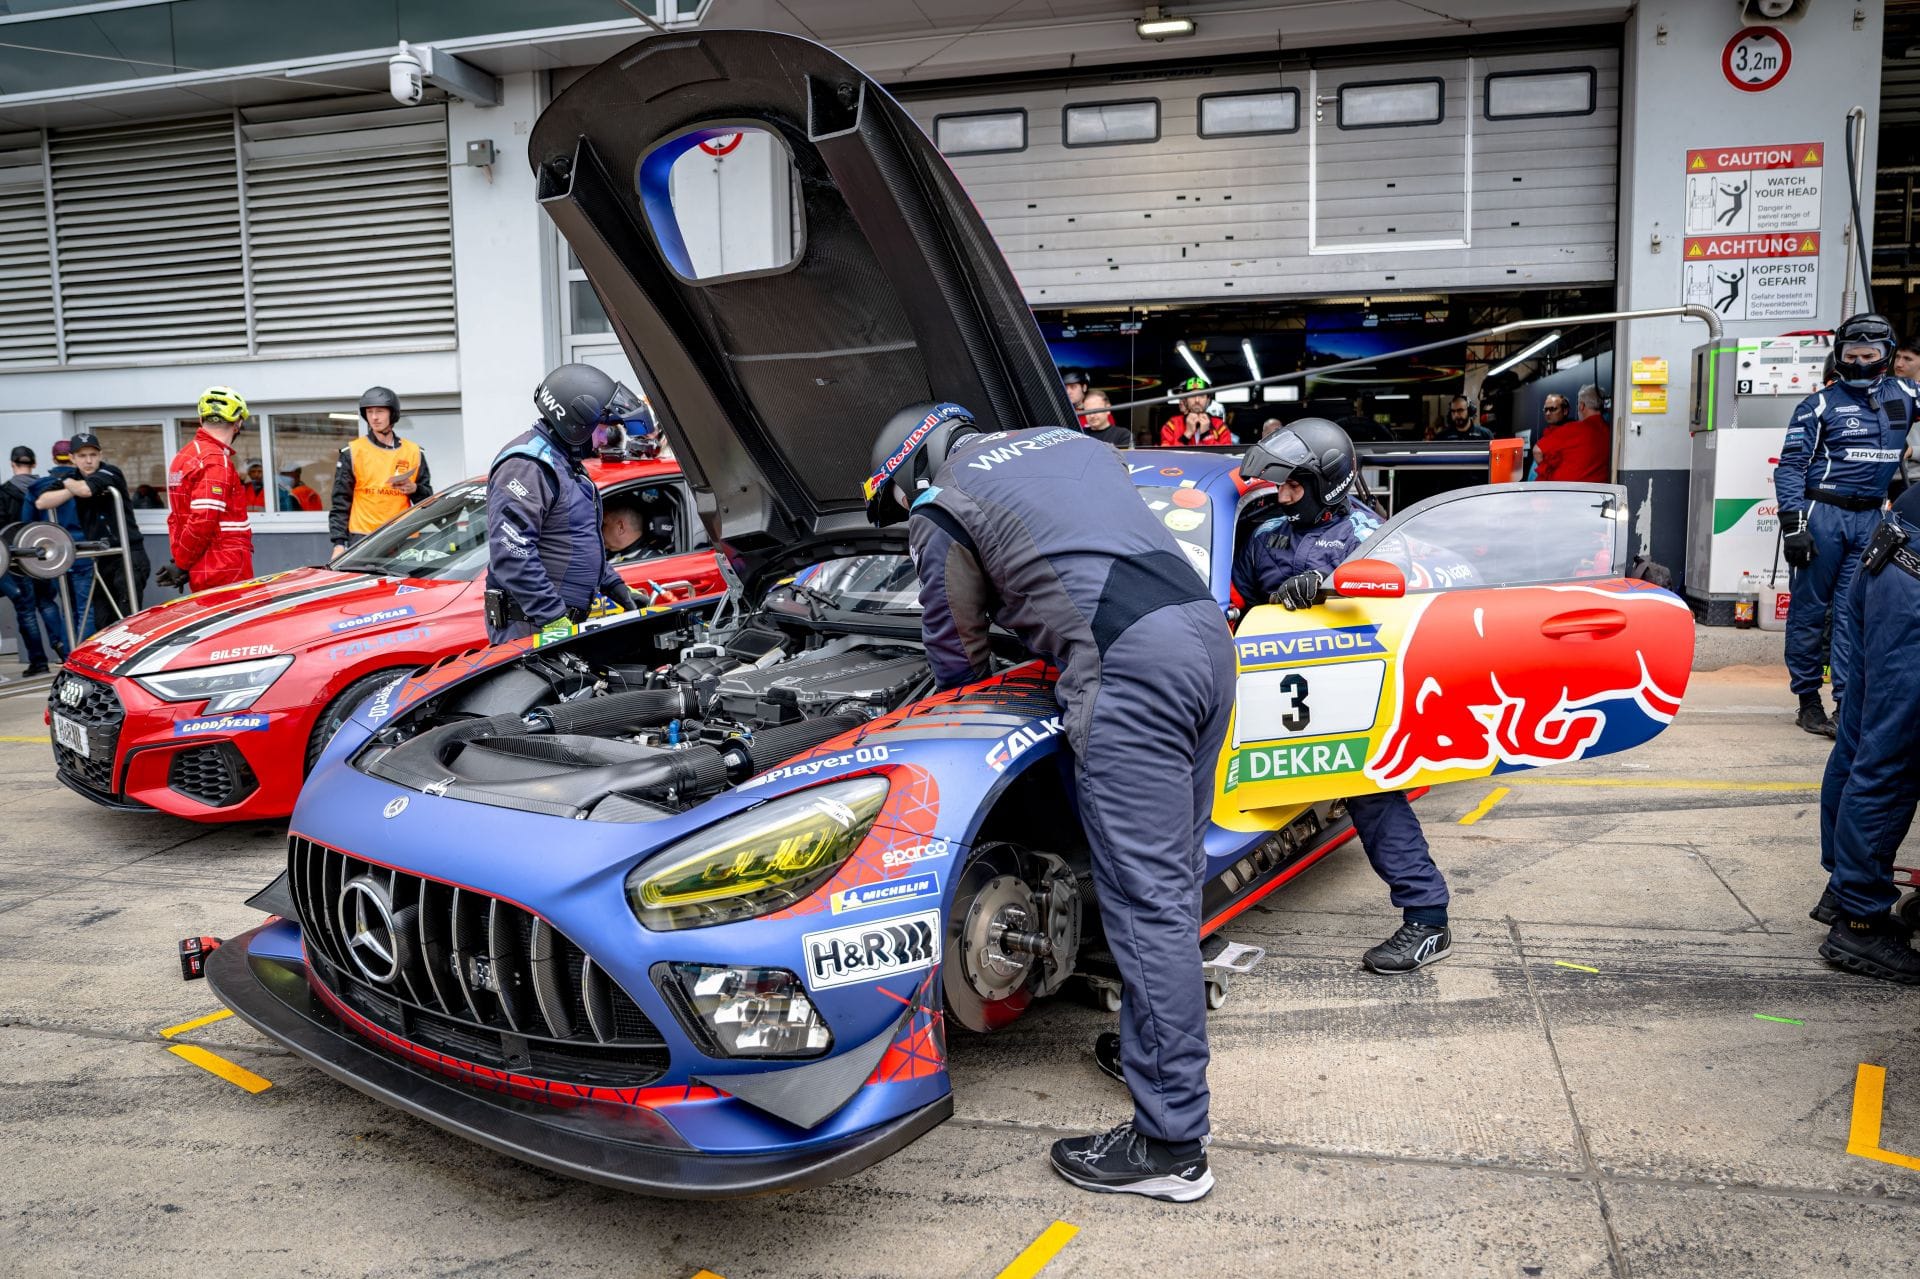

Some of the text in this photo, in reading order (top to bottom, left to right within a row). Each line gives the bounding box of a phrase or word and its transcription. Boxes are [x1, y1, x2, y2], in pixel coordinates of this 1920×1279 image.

[1717, 150, 1792, 167] CAUTION
[1767, 176, 1806, 186] WATCH
[1755, 187, 1818, 198] YOUR HEAD
[1757, 204, 1783, 212] Danger
[1706, 237, 1798, 256] ACHTUNG
[1758, 276, 1807, 287] GEFAHR
[1740, 381, 1750, 394] 9
[886, 413, 940, 472] Red Bull
[1851, 451, 1898, 460] RAVENOL
[1324, 470, 1354, 502] BERKAN
[1358, 581, 1399, 590] AMG
[338, 608, 408, 629] GOODYEAR
[209, 644, 274, 661] BILSTEIN
[329, 627, 431, 660] FALKEN
[1240, 633, 1372, 659] RAVENOL
[1279, 673, 1311, 732] 3
[182, 717, 261, 732] GOODYEAR
[985, 716, 1066, 774] FALK
[764, 745, 889, 784] Player 0.0
[1249, 742, 1356, 779] DEKRA
[882, 841, 948, 867] sparco
[862, 880, 929, 901] MICHELIN
[812, 932, 890, 976] H&R
